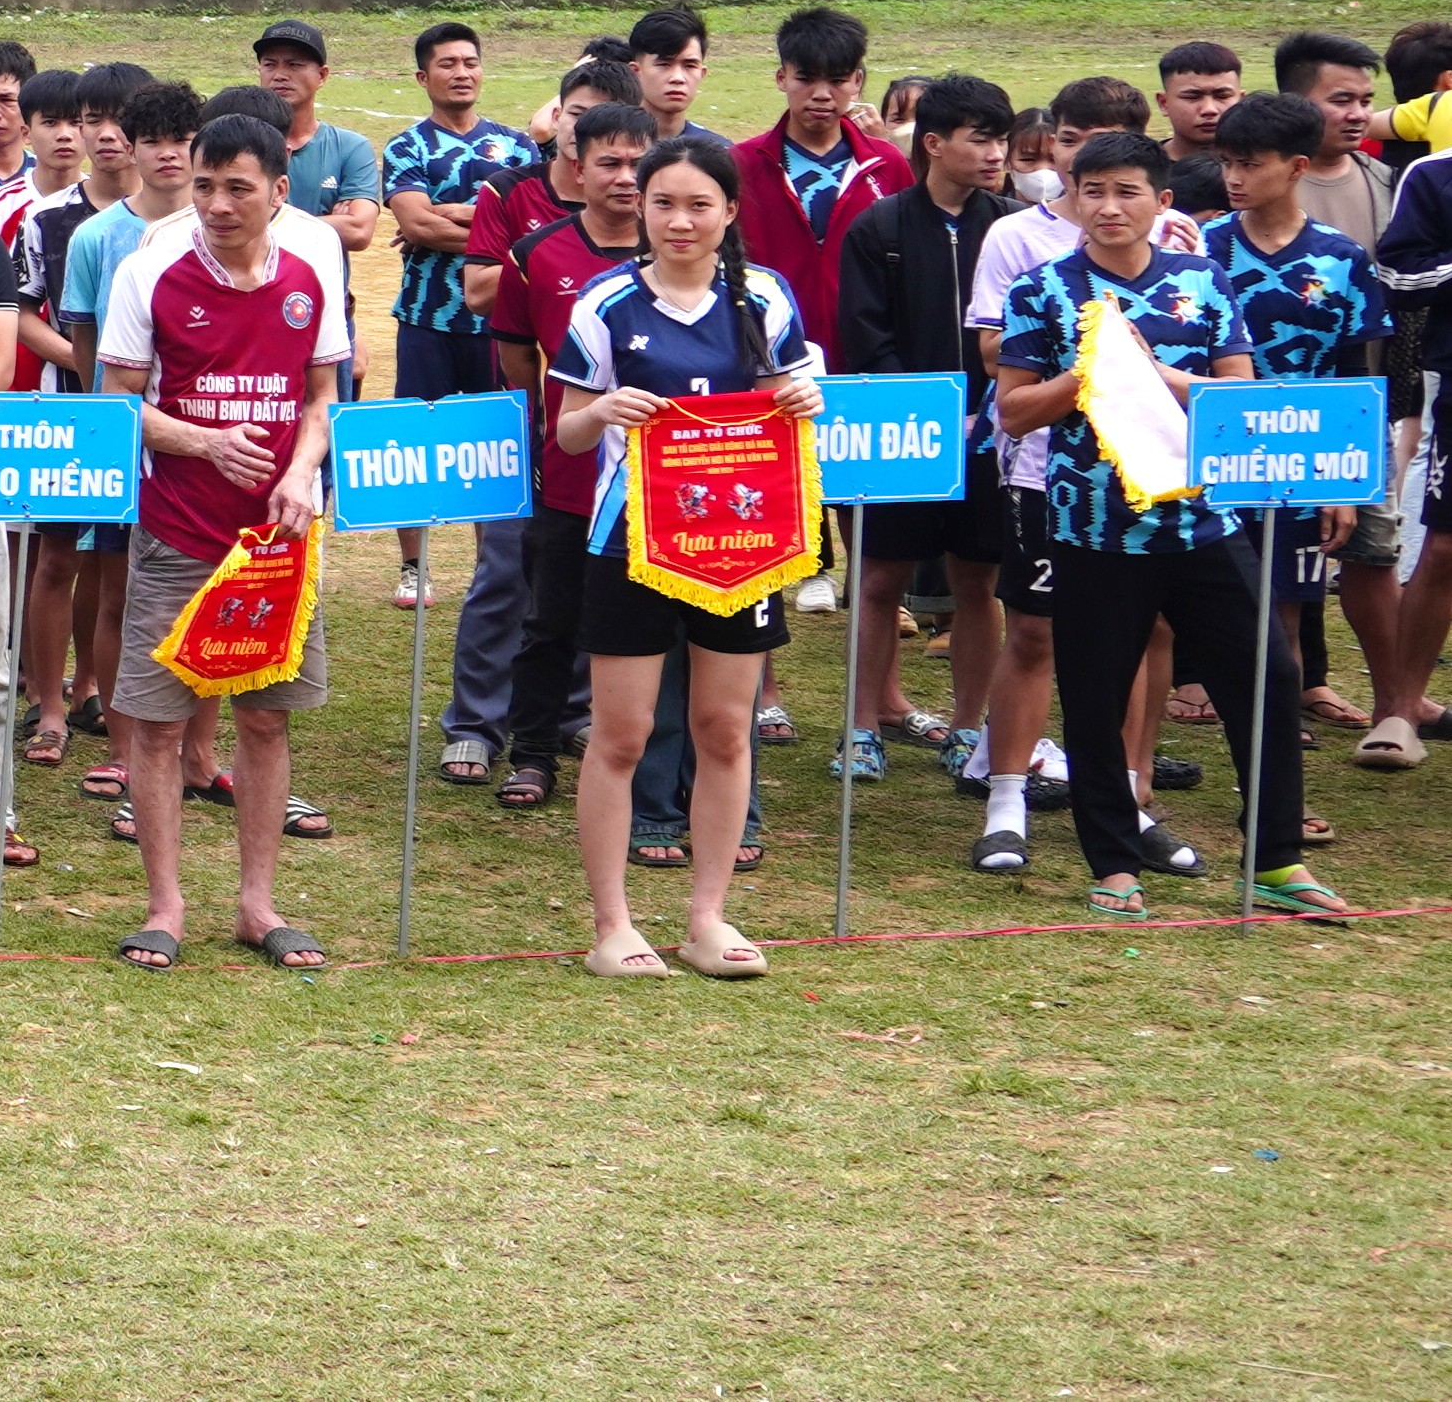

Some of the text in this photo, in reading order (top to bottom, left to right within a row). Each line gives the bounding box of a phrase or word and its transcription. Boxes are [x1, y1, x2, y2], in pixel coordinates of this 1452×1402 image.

[196, 372, 288, 398] CÔNG TY LUẬT
[178, 398, 216, 419] TNHH
[219, 400, 251, 420] BMV
[253, 393, 279, 421] ĐẤT
[1242, 405, 1320, 434] THÔN
[671, 423, 763, 440] BAN TỔ CHỨC
[814, 413, 942, 462] HÔN ĐÁC
[29, 458, 124, 498] HIỀNG
[343, 438, 519, 489] THÔN PỌNG
[1201, 443, 1368, 485] CHIỀNG MỚI
[672, 529, 777, 557] Lưu niệm
[1029, 558, 1054, 593] 2
[1295, 545, 1325, 583] 17
[199, 636, 269, 661] Lưu niệm
